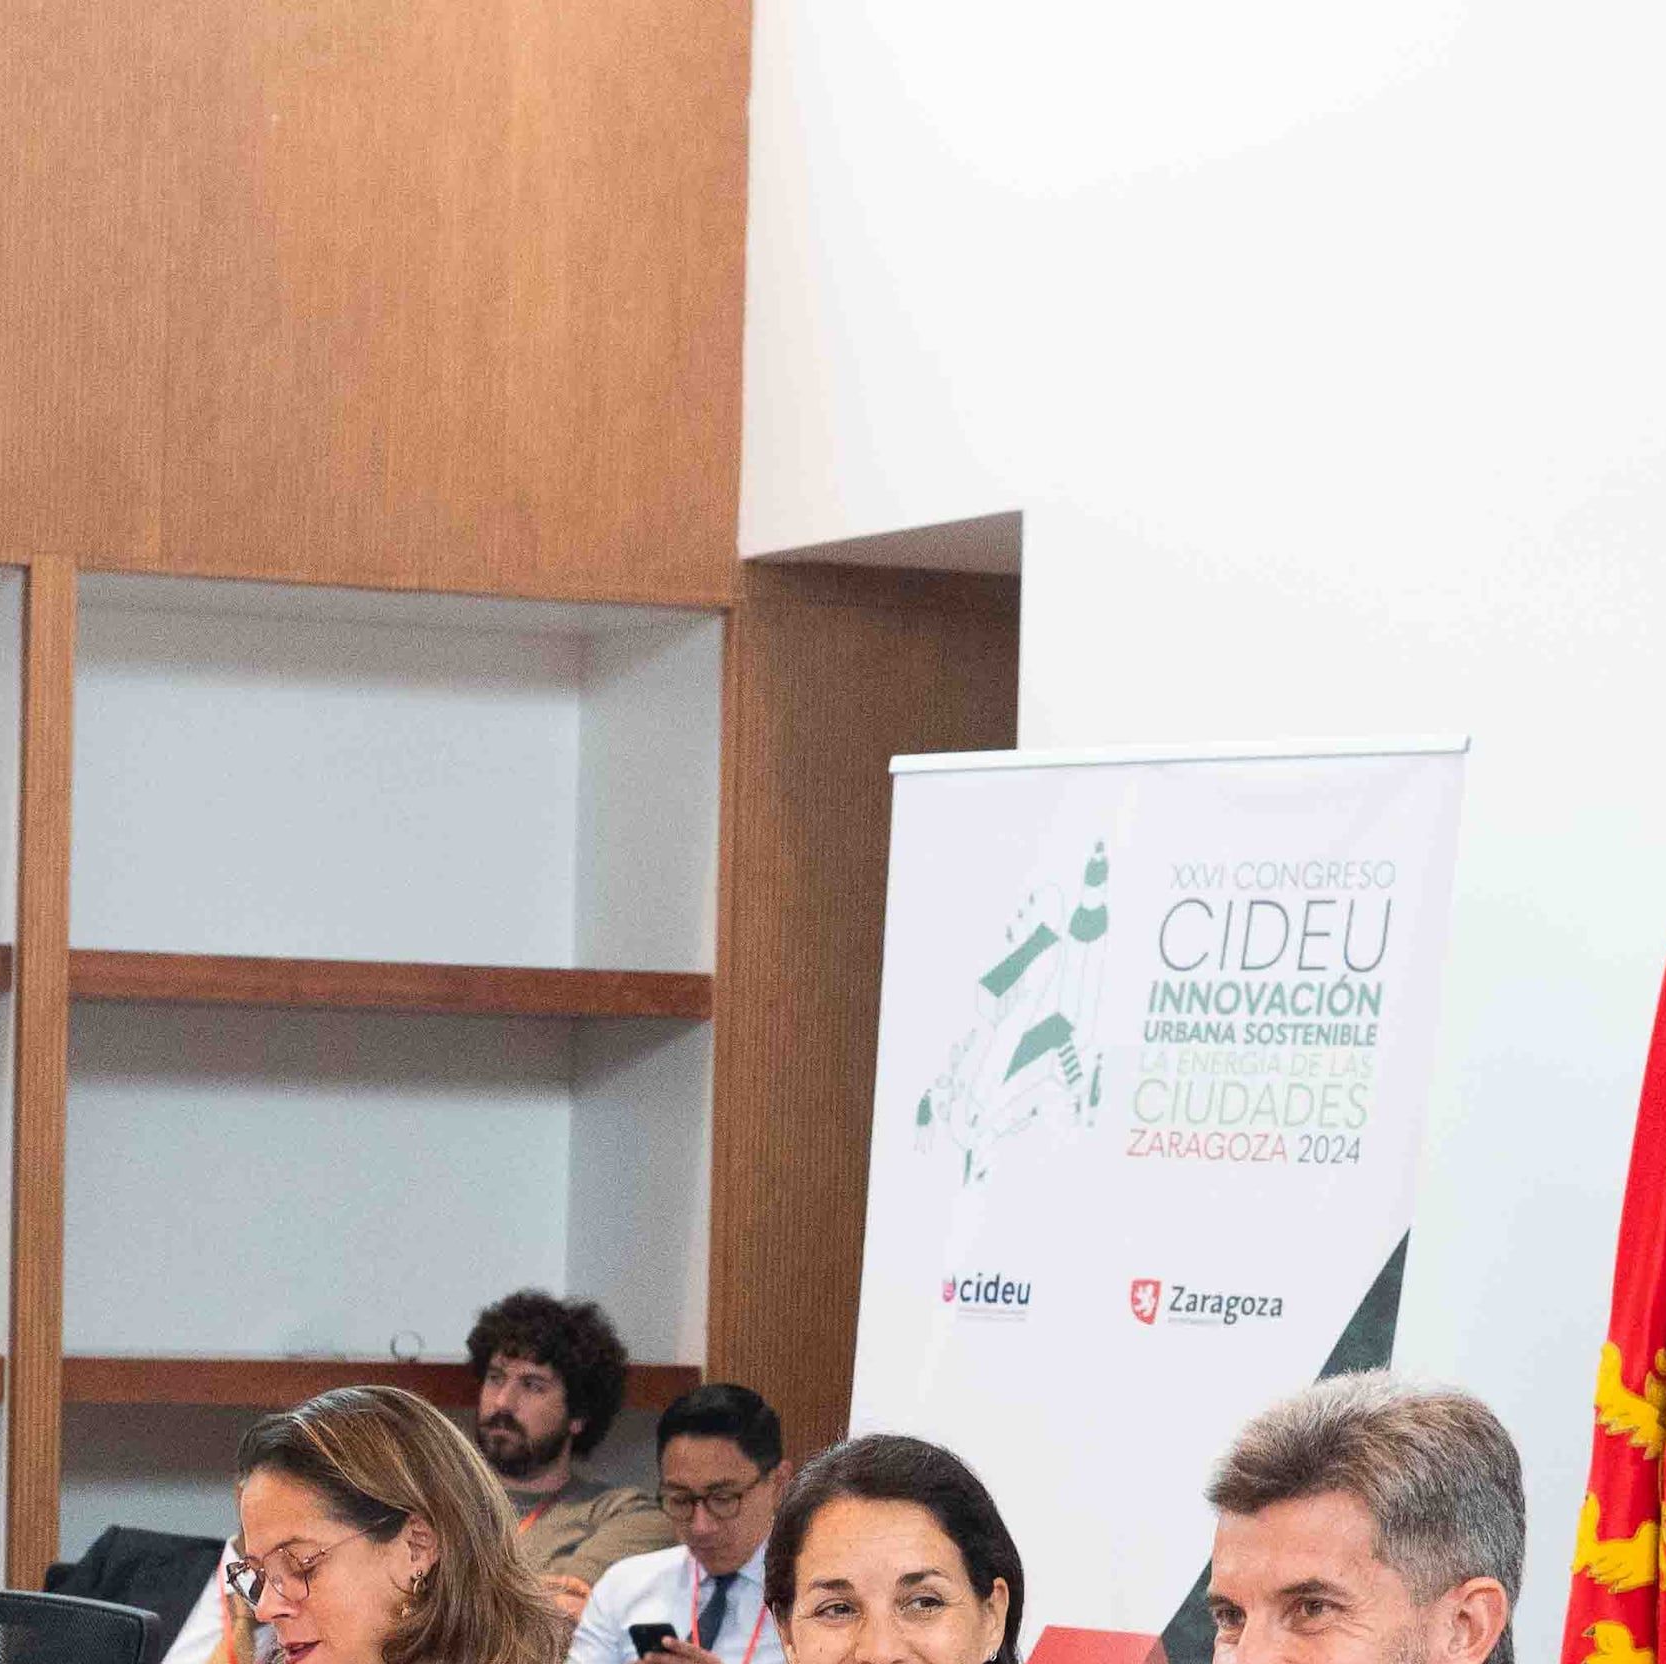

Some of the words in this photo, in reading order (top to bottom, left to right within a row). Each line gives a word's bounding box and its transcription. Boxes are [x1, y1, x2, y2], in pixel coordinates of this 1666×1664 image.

[1170, 862, 1224, 889] XXVI
[1234, 860, 1396, 890] CONGRESO
[1159, 898, 1391, 972] CIDEU
[1148, 974, 1383, 1017] INNOVACIÓN
[1144, 1020, 1236, 1044] URBANA
[1243, 1022, 1378, 1046] SOSTENIBLE
[1138, 1051, 1168, 1073] LA
[1290, 1053, 1322, 1077] DE
[1329, 1053, 1373, 1078] LAS
[1134, 1078, 1369, 1130] CIUDADES
[1126, 1129, 1288, 1163] ZARAGOZA
[1297, 1135, 1361, 1164] 2024
[960, 1272, 1031, 1305] cideu
[1169, 1285, 1284, 1325] Zaragoza
